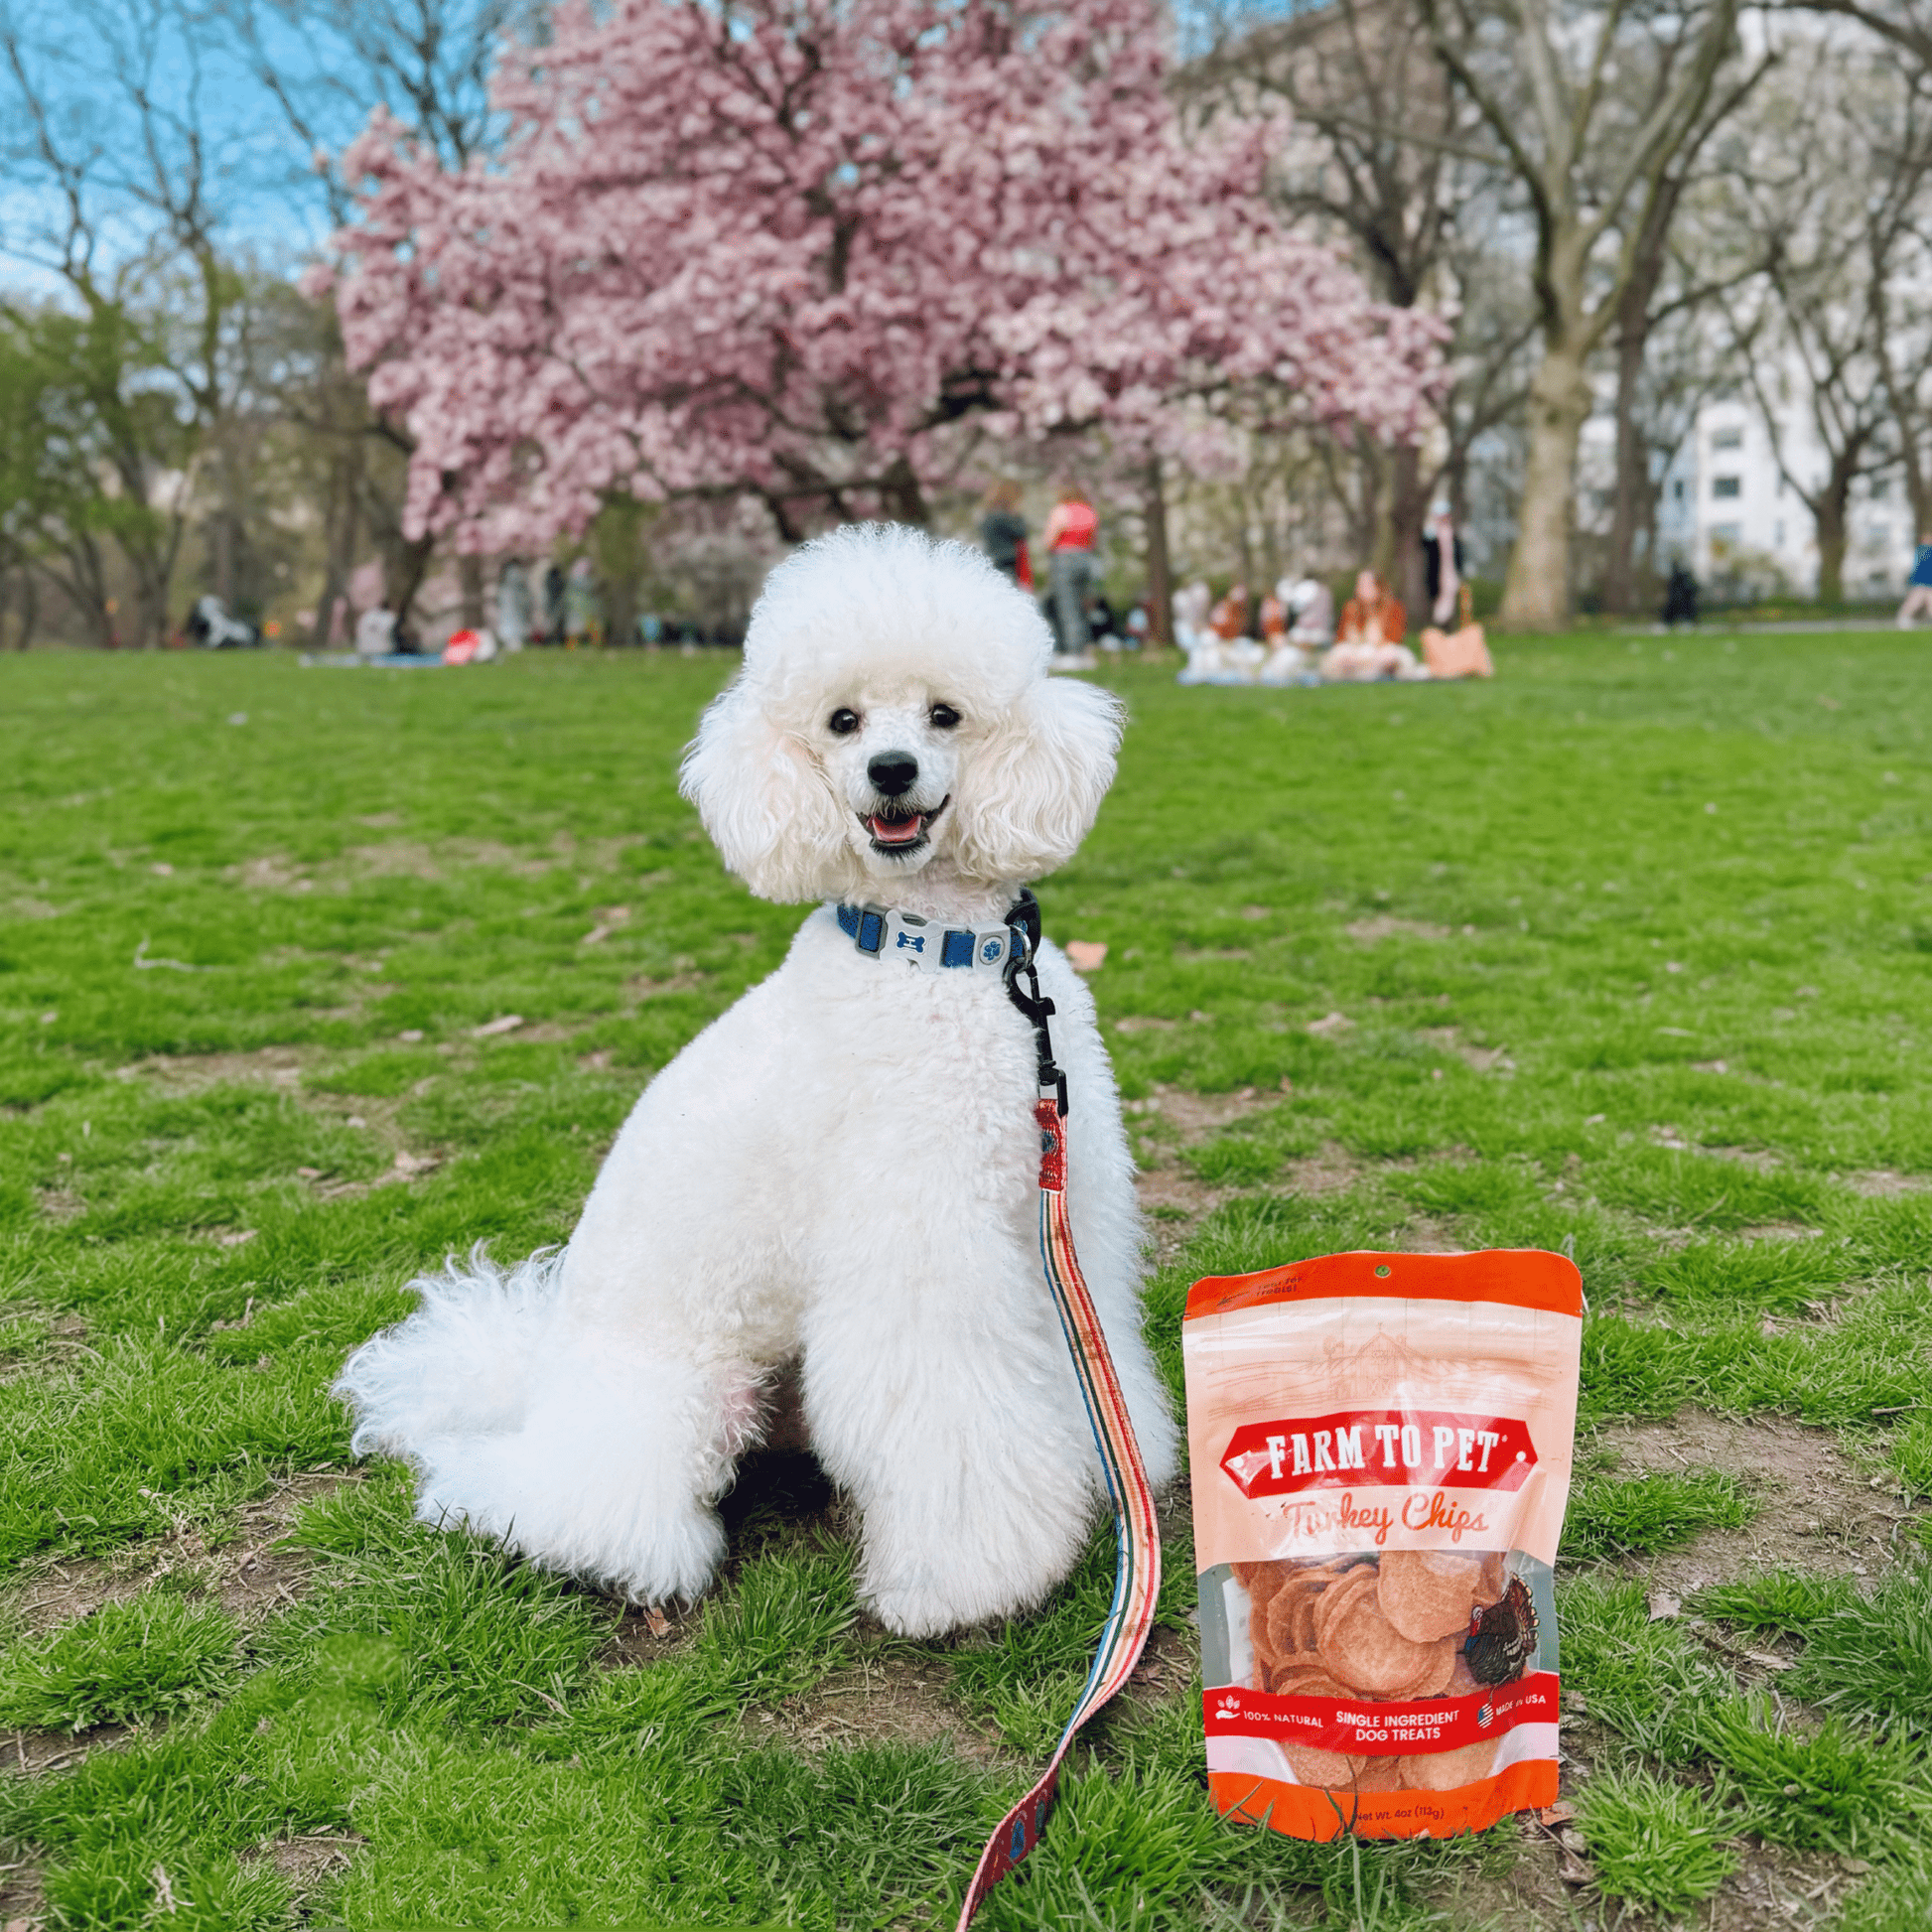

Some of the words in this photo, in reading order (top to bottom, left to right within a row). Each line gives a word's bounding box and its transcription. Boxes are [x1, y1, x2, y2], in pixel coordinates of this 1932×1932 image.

[1267, 1426, 1365, 1479] FARM
[1375, 1424, 1421, 1468] TO
[1401, 1490, 1490, 1544] Chips
[1495, 1700, 1514, 1717] MADE
[1525, 1693, 1547, 1705] USA
[1243, 1711, 1272, 1722] 100%
[1274, 1714, 1323, 1728] NATURAL
[1335, 1710, 1380, 1727] SINGLE
[1384, 1710, 1459, 1727] INGREDIENT
[1355, 1728, 1388, 1742] DOG
[1392, 1726, 1442, 1741] TREATS
[1394, 1808, 1413, 1819] 4oz
[1414, 1805, 1445, 1821] (113g)
